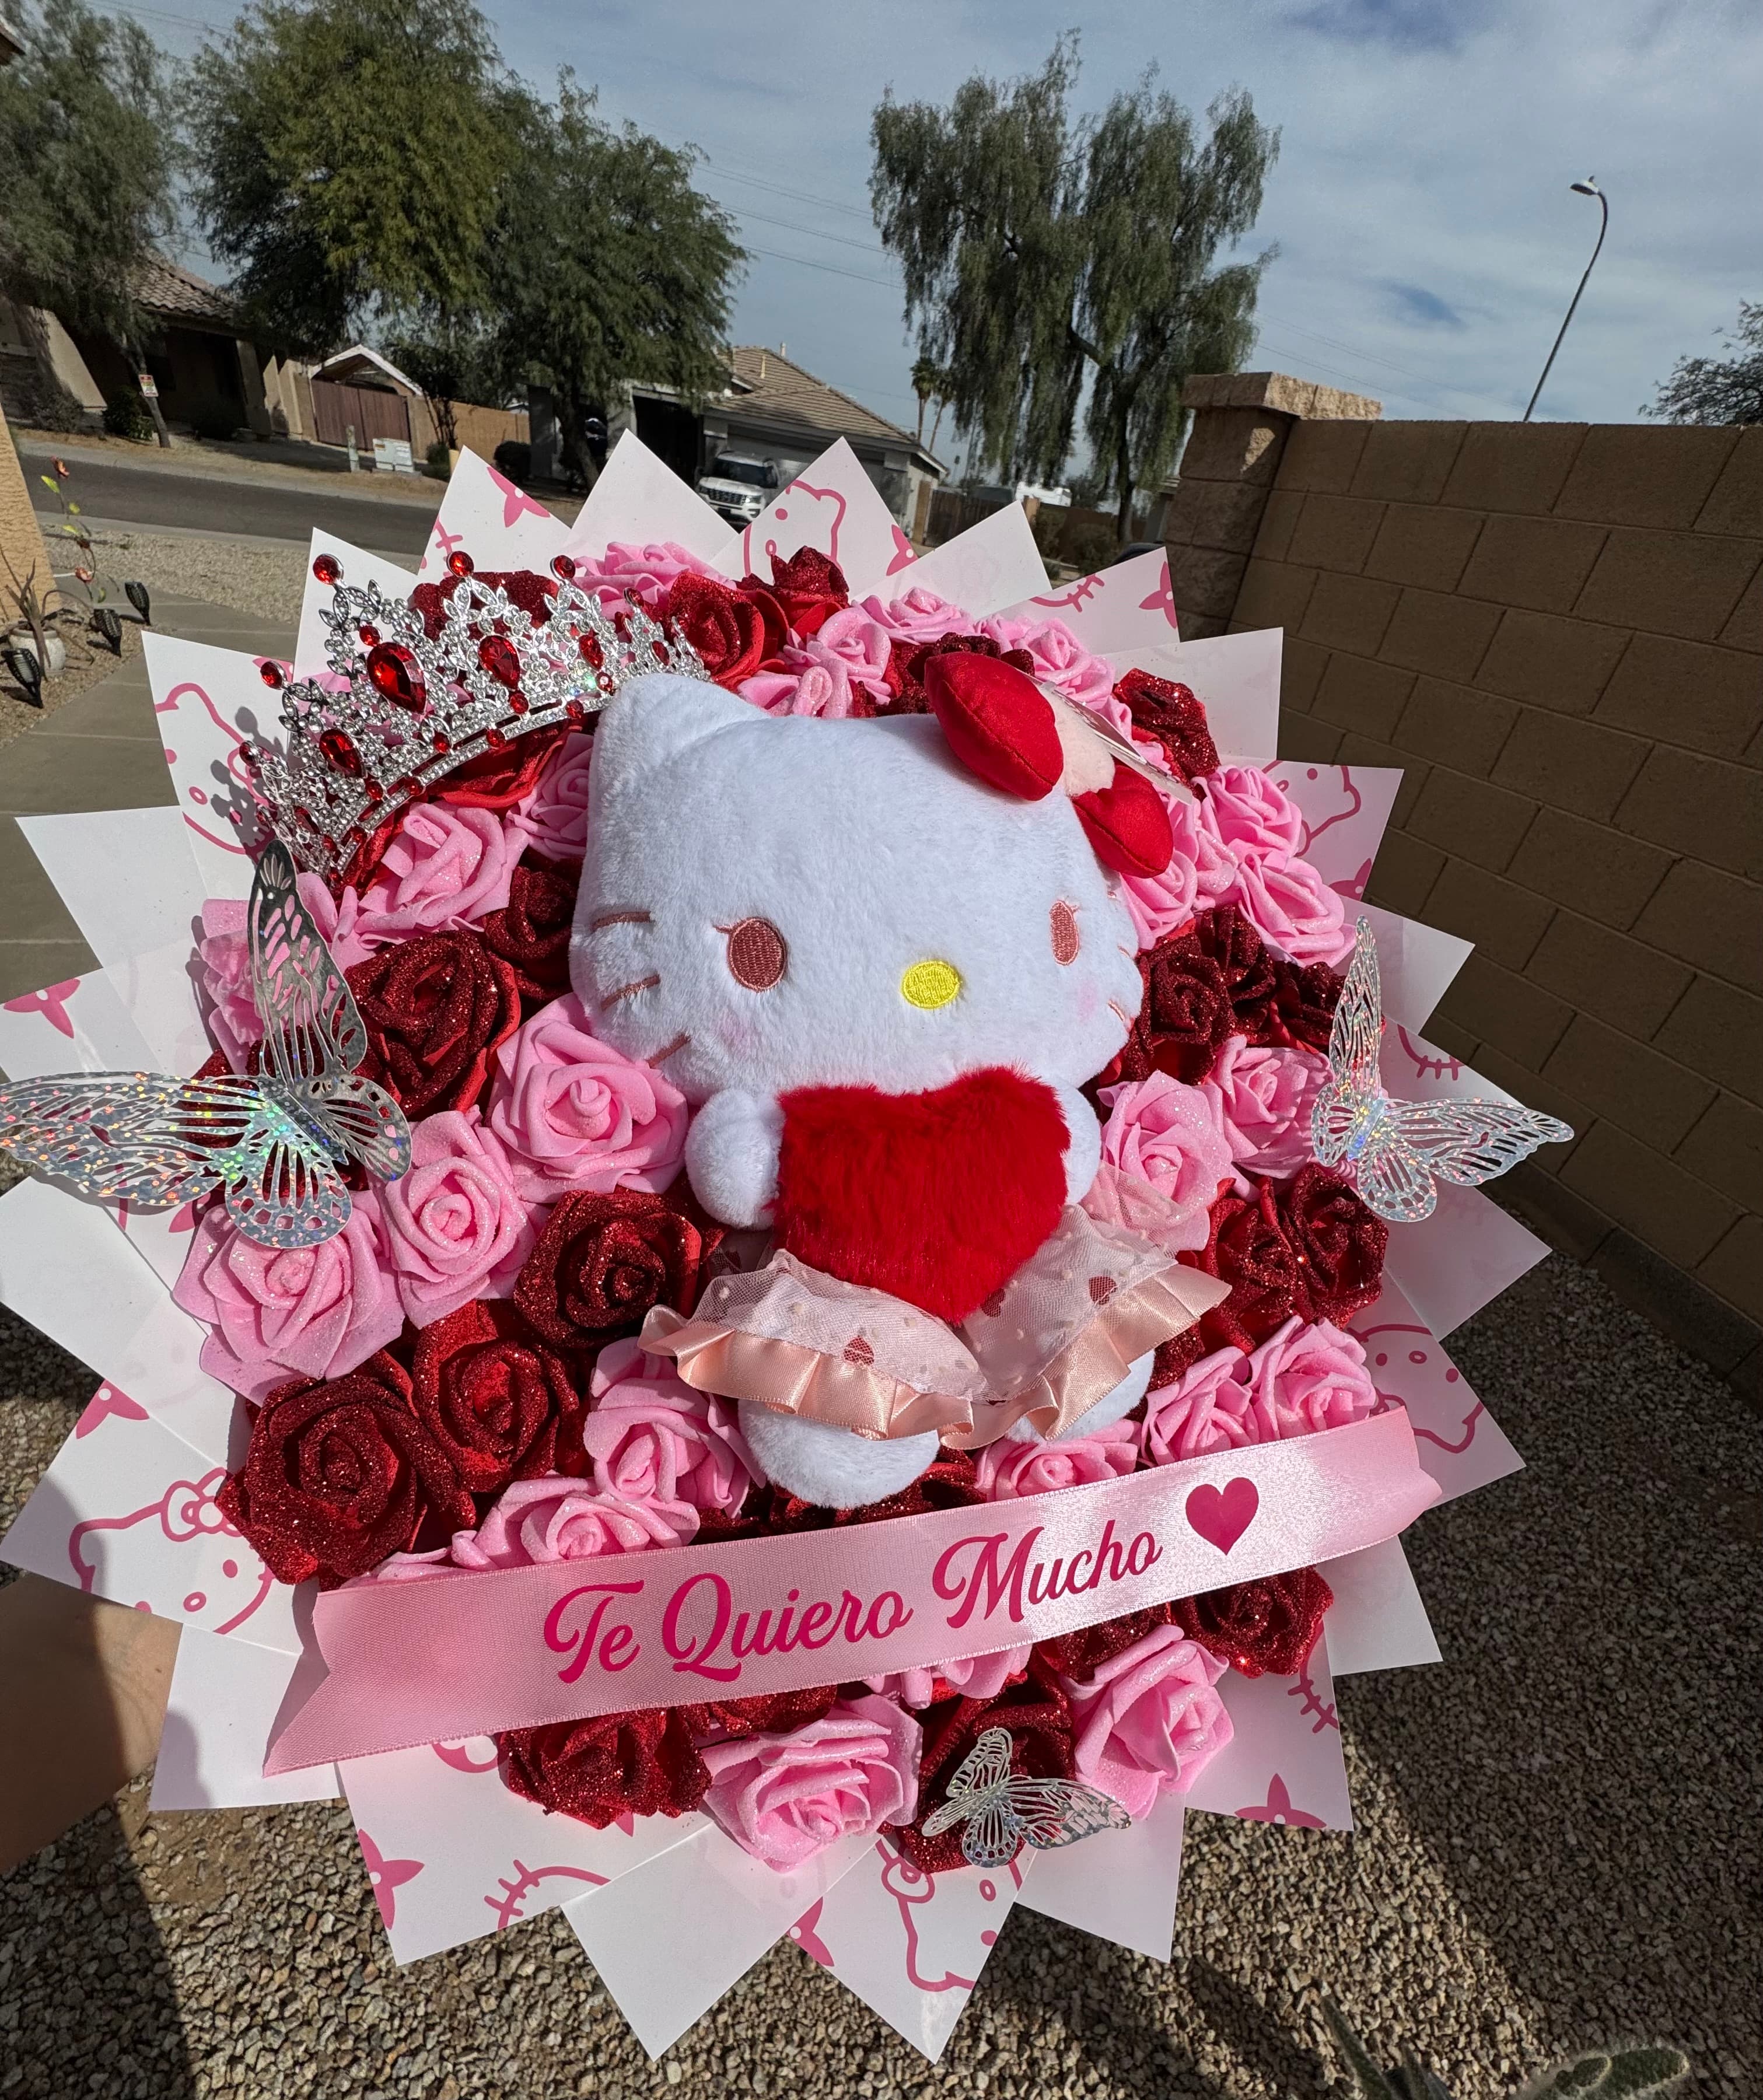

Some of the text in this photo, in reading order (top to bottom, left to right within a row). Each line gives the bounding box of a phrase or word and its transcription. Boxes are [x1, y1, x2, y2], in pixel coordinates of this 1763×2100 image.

[544, 1520, 1162, 1684] Te Quiero Mucho
